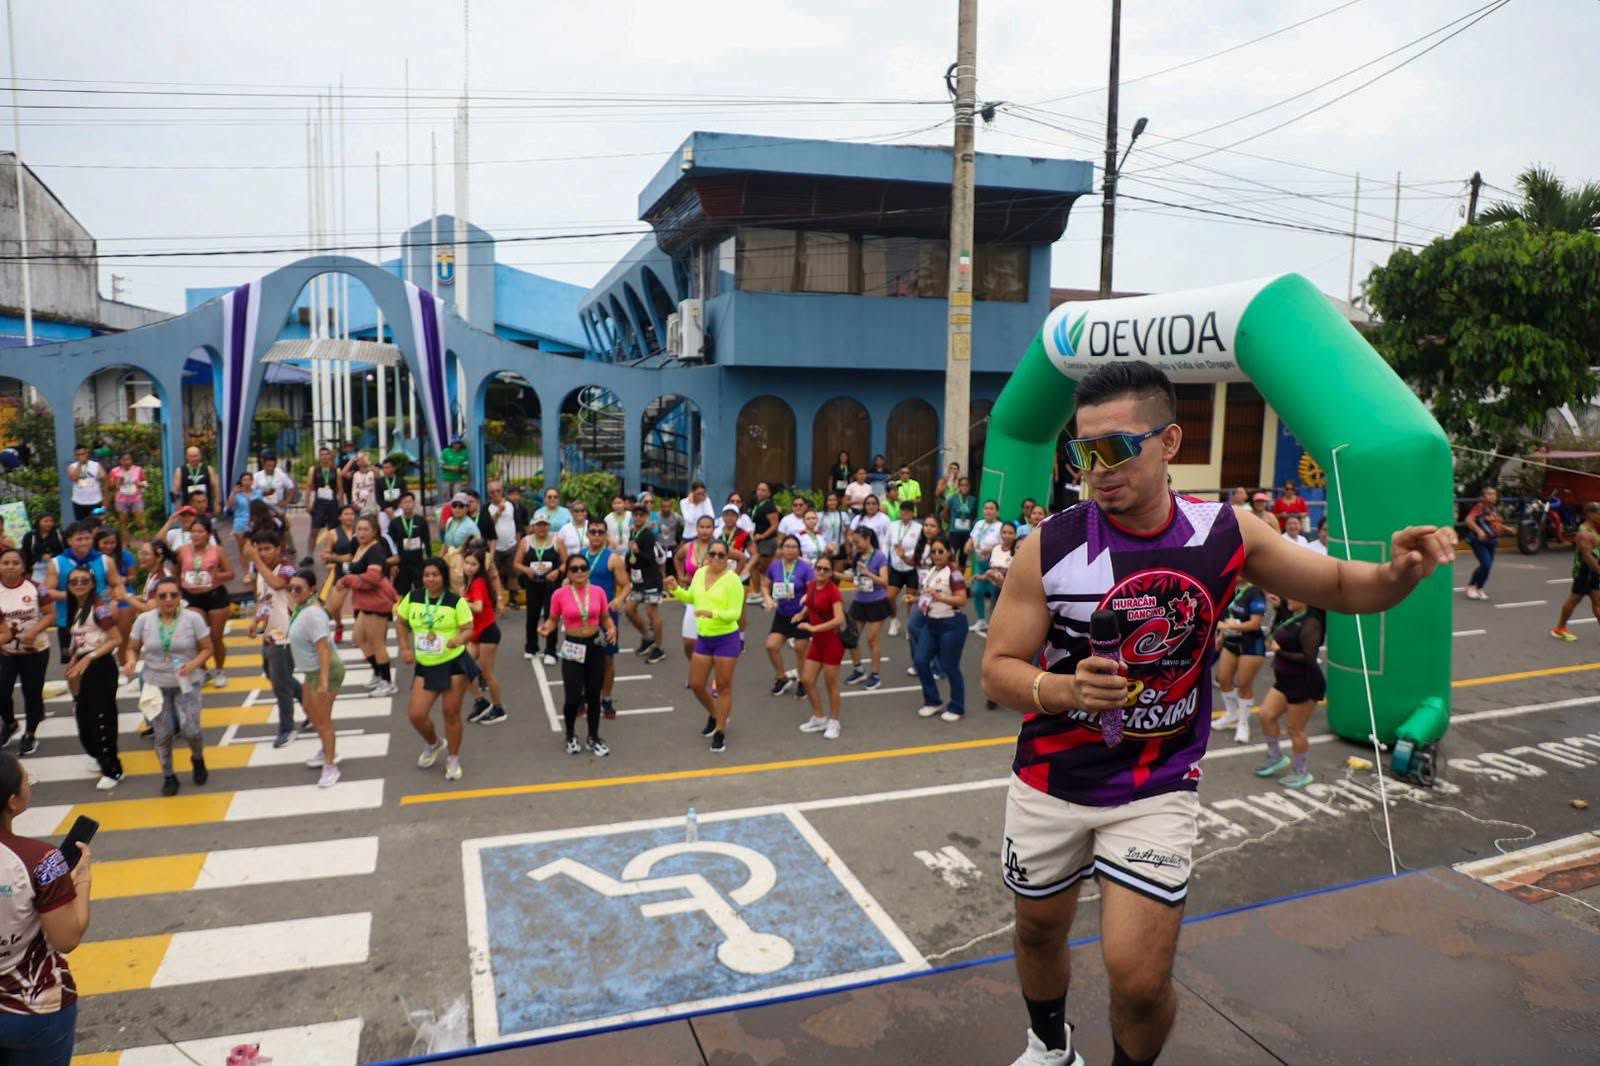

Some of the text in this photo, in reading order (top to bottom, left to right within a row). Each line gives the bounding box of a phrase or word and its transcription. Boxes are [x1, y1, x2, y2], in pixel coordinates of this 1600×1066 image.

[1089, 311, 1227, 357] DEVIDA
[1113, 595, 1157, 610] HURACÁN
[1127, 608, 1166, 621] DANCING
[1005, 836, 1030, 883] LA
[1125, 846, 1140, 859] Los
